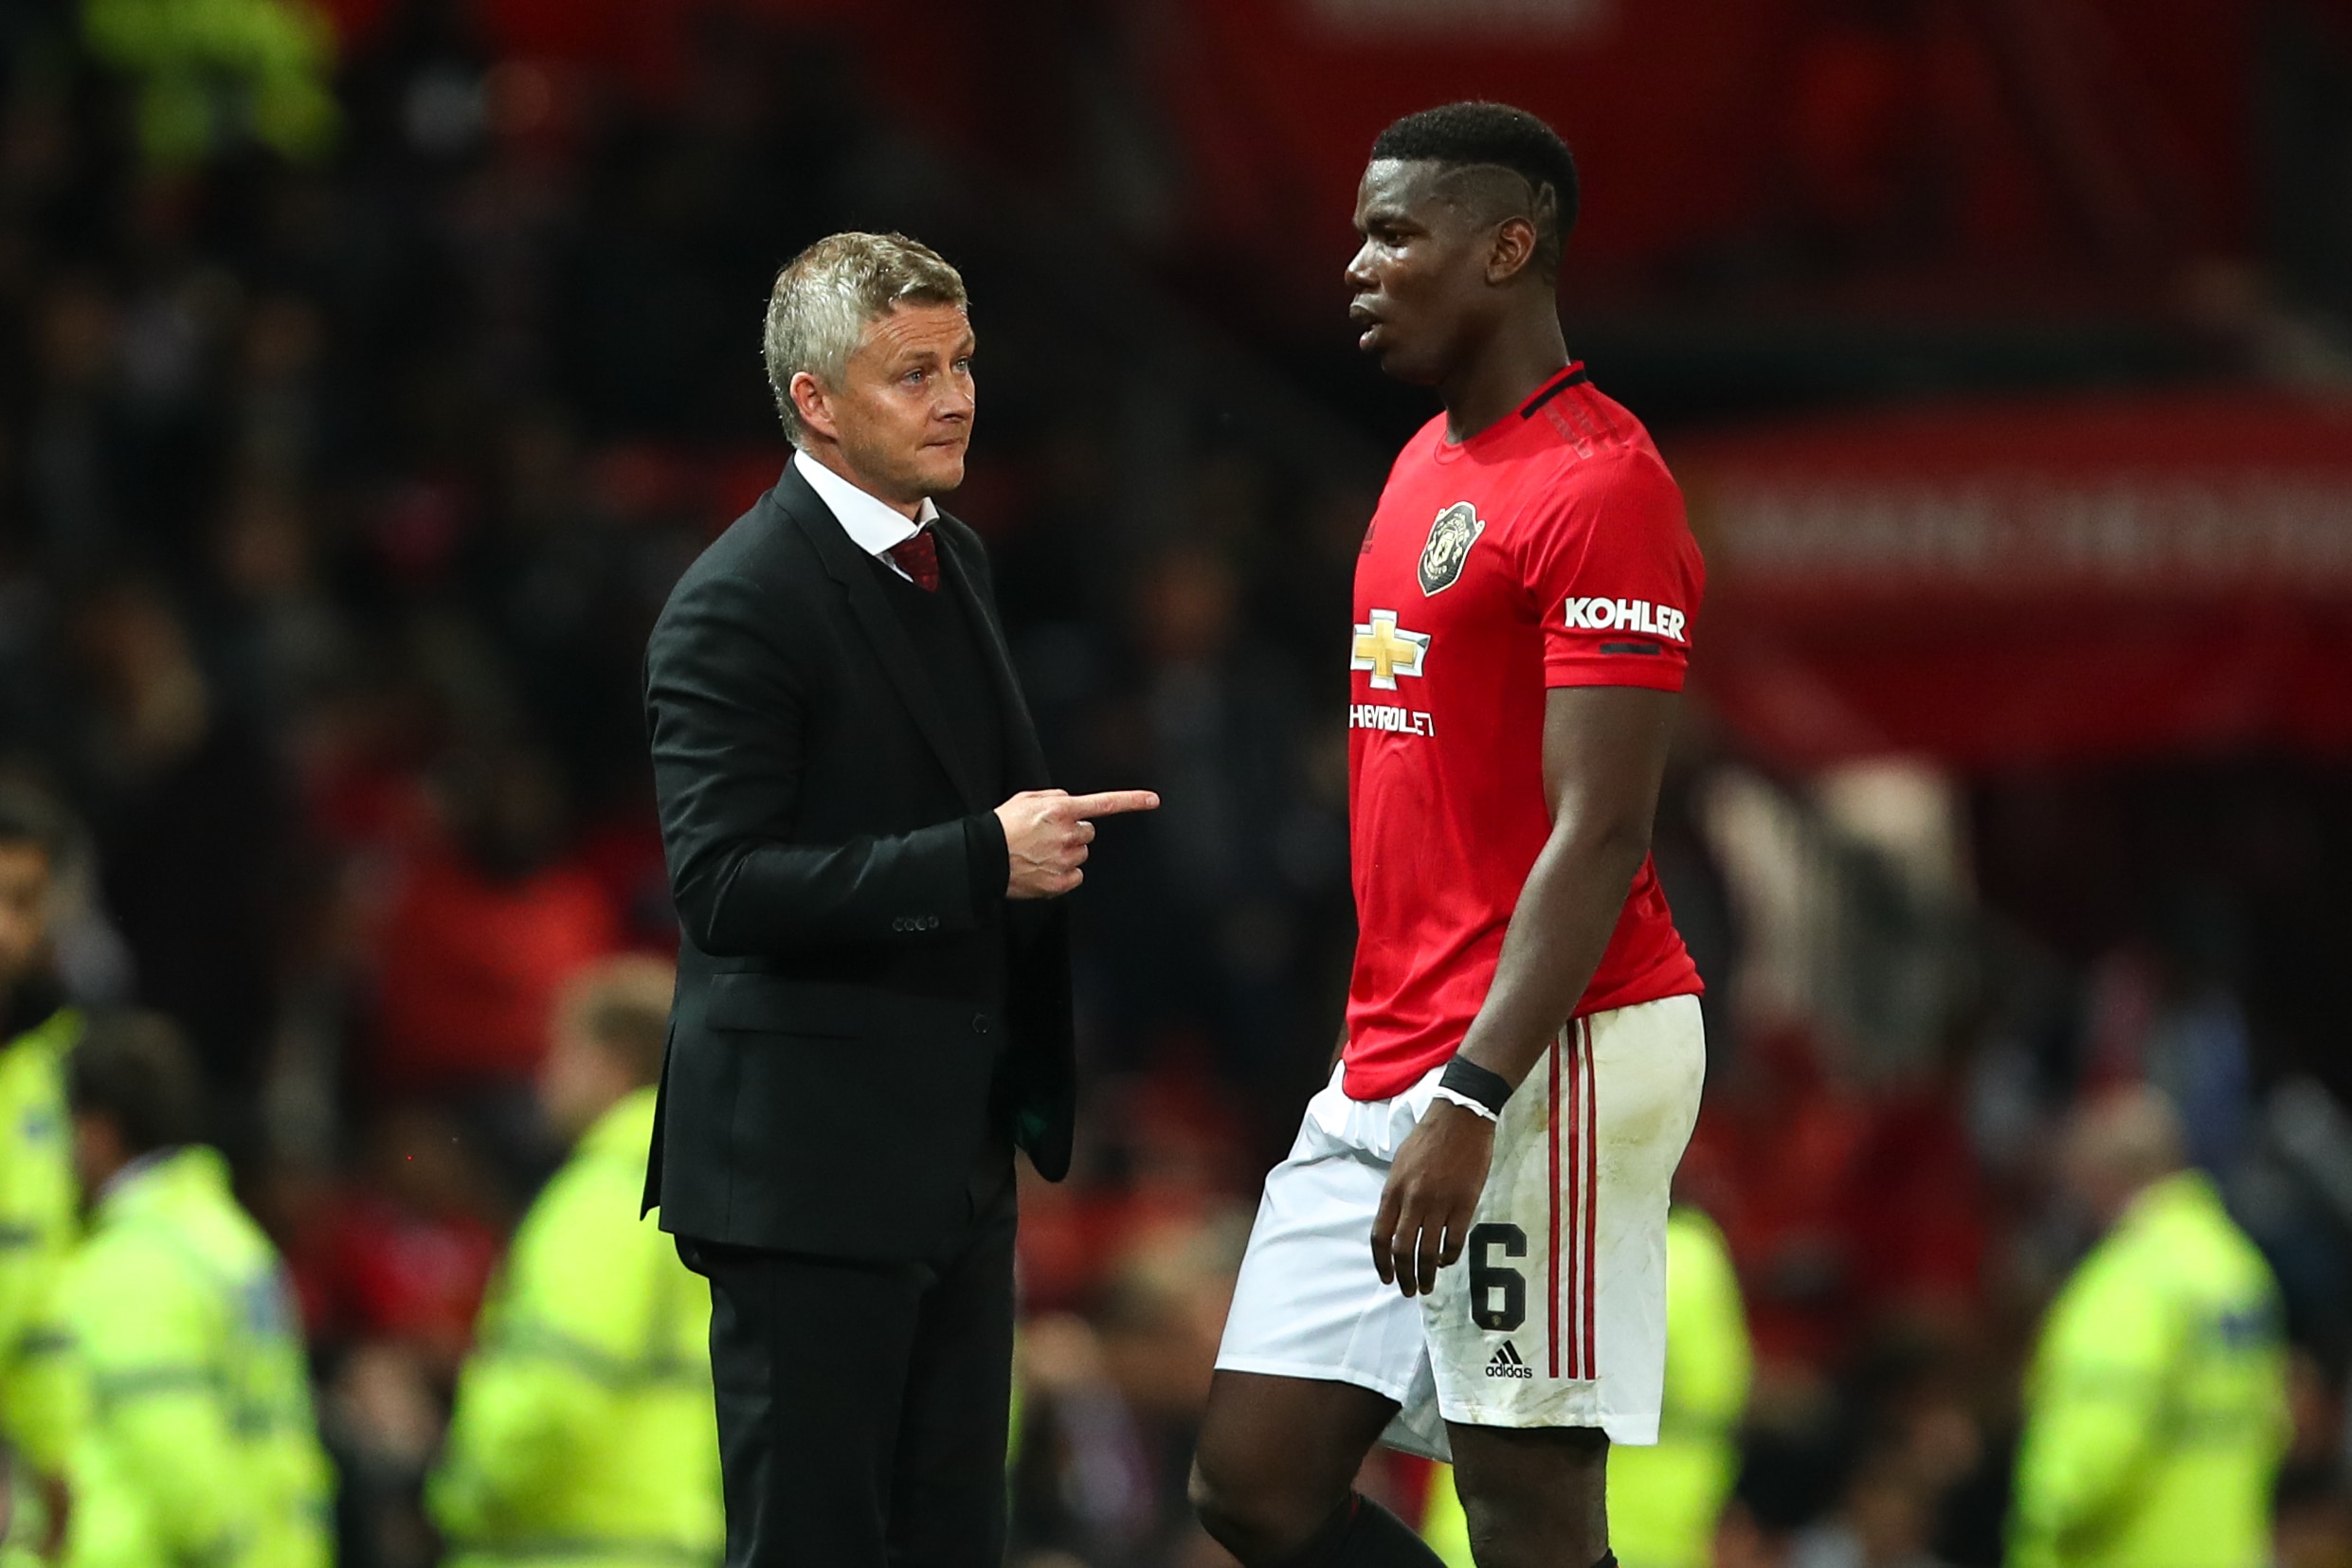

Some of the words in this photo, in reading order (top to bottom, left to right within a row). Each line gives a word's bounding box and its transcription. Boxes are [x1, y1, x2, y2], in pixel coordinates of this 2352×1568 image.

[1565, 597, 1685, 642] KOHLER
[1349, 704, 1435, 737] HEVROLET
[1469, 1223, 1527, 1331] 6
[1485, 1364, 1532, 1379] adidas
